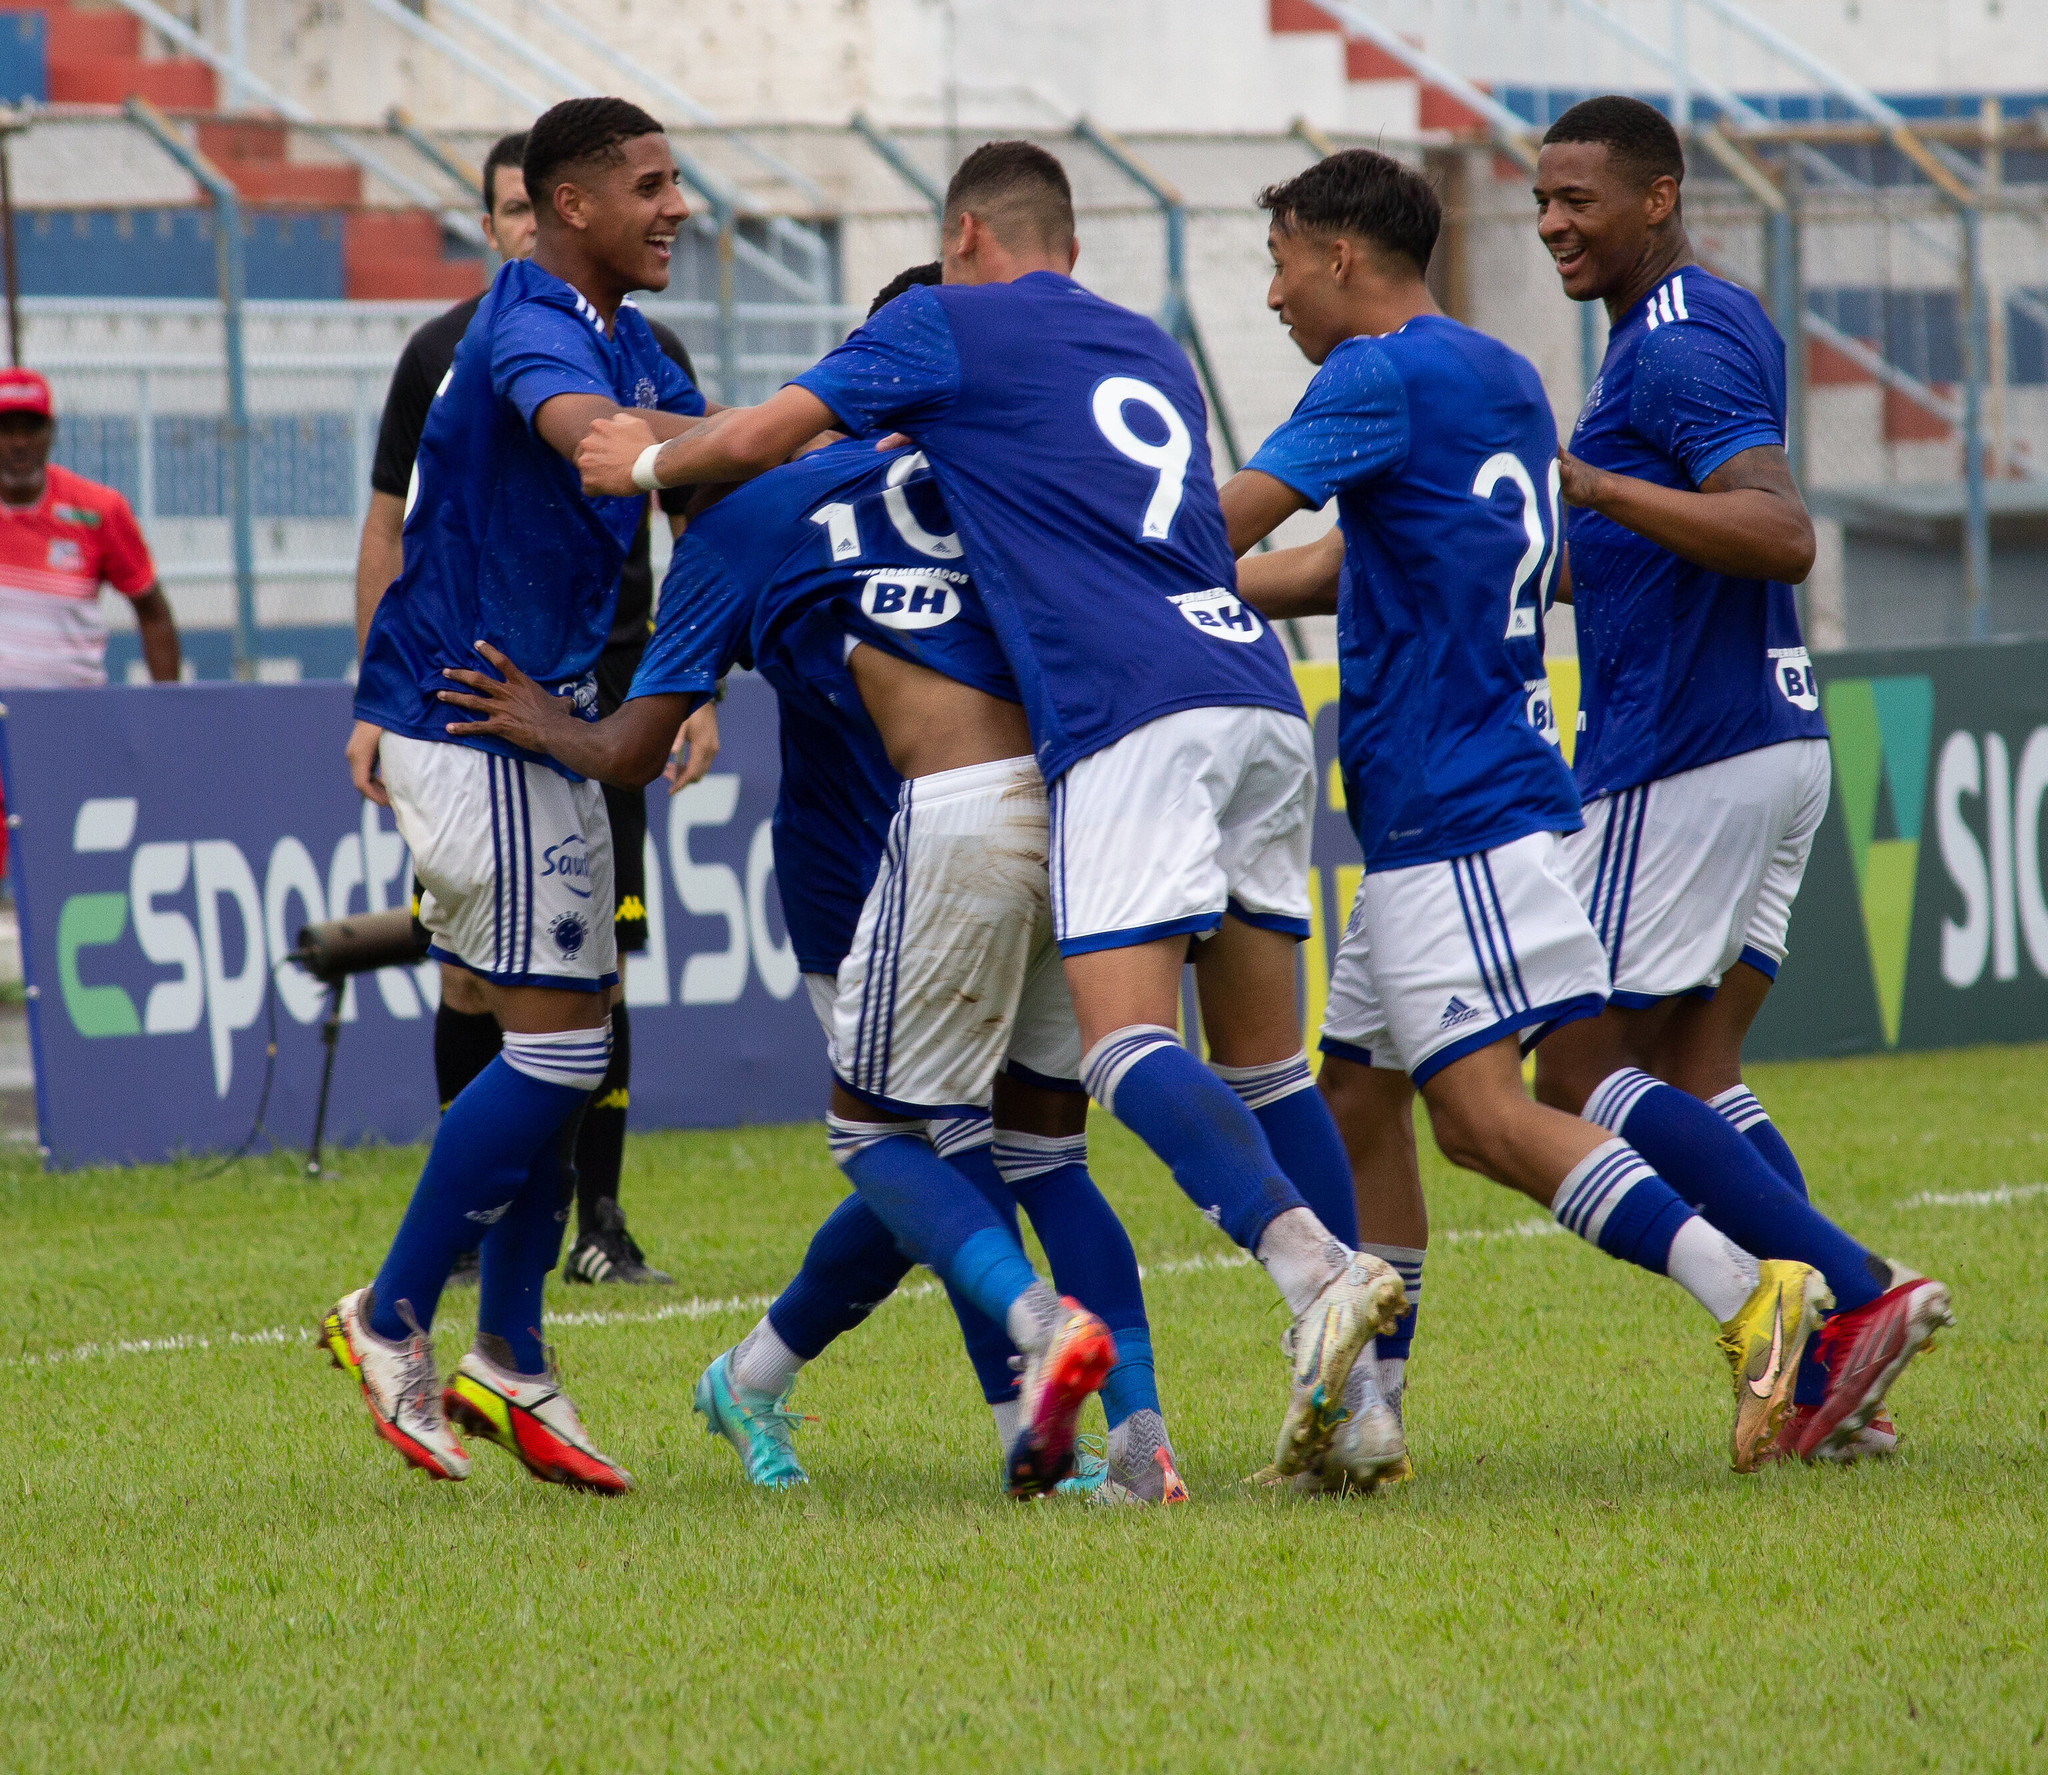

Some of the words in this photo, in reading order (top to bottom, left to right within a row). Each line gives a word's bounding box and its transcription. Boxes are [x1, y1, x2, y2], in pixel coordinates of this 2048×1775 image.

[1092, 377, 1192, 540] 9
[809, 450, 964, 562] 10
[1472, 452, 1561, 640] 2
[870, 582, 948, 614] BH
[1188, 605, 1253, 632] BH
[1532, 697, 1555, 731] B
